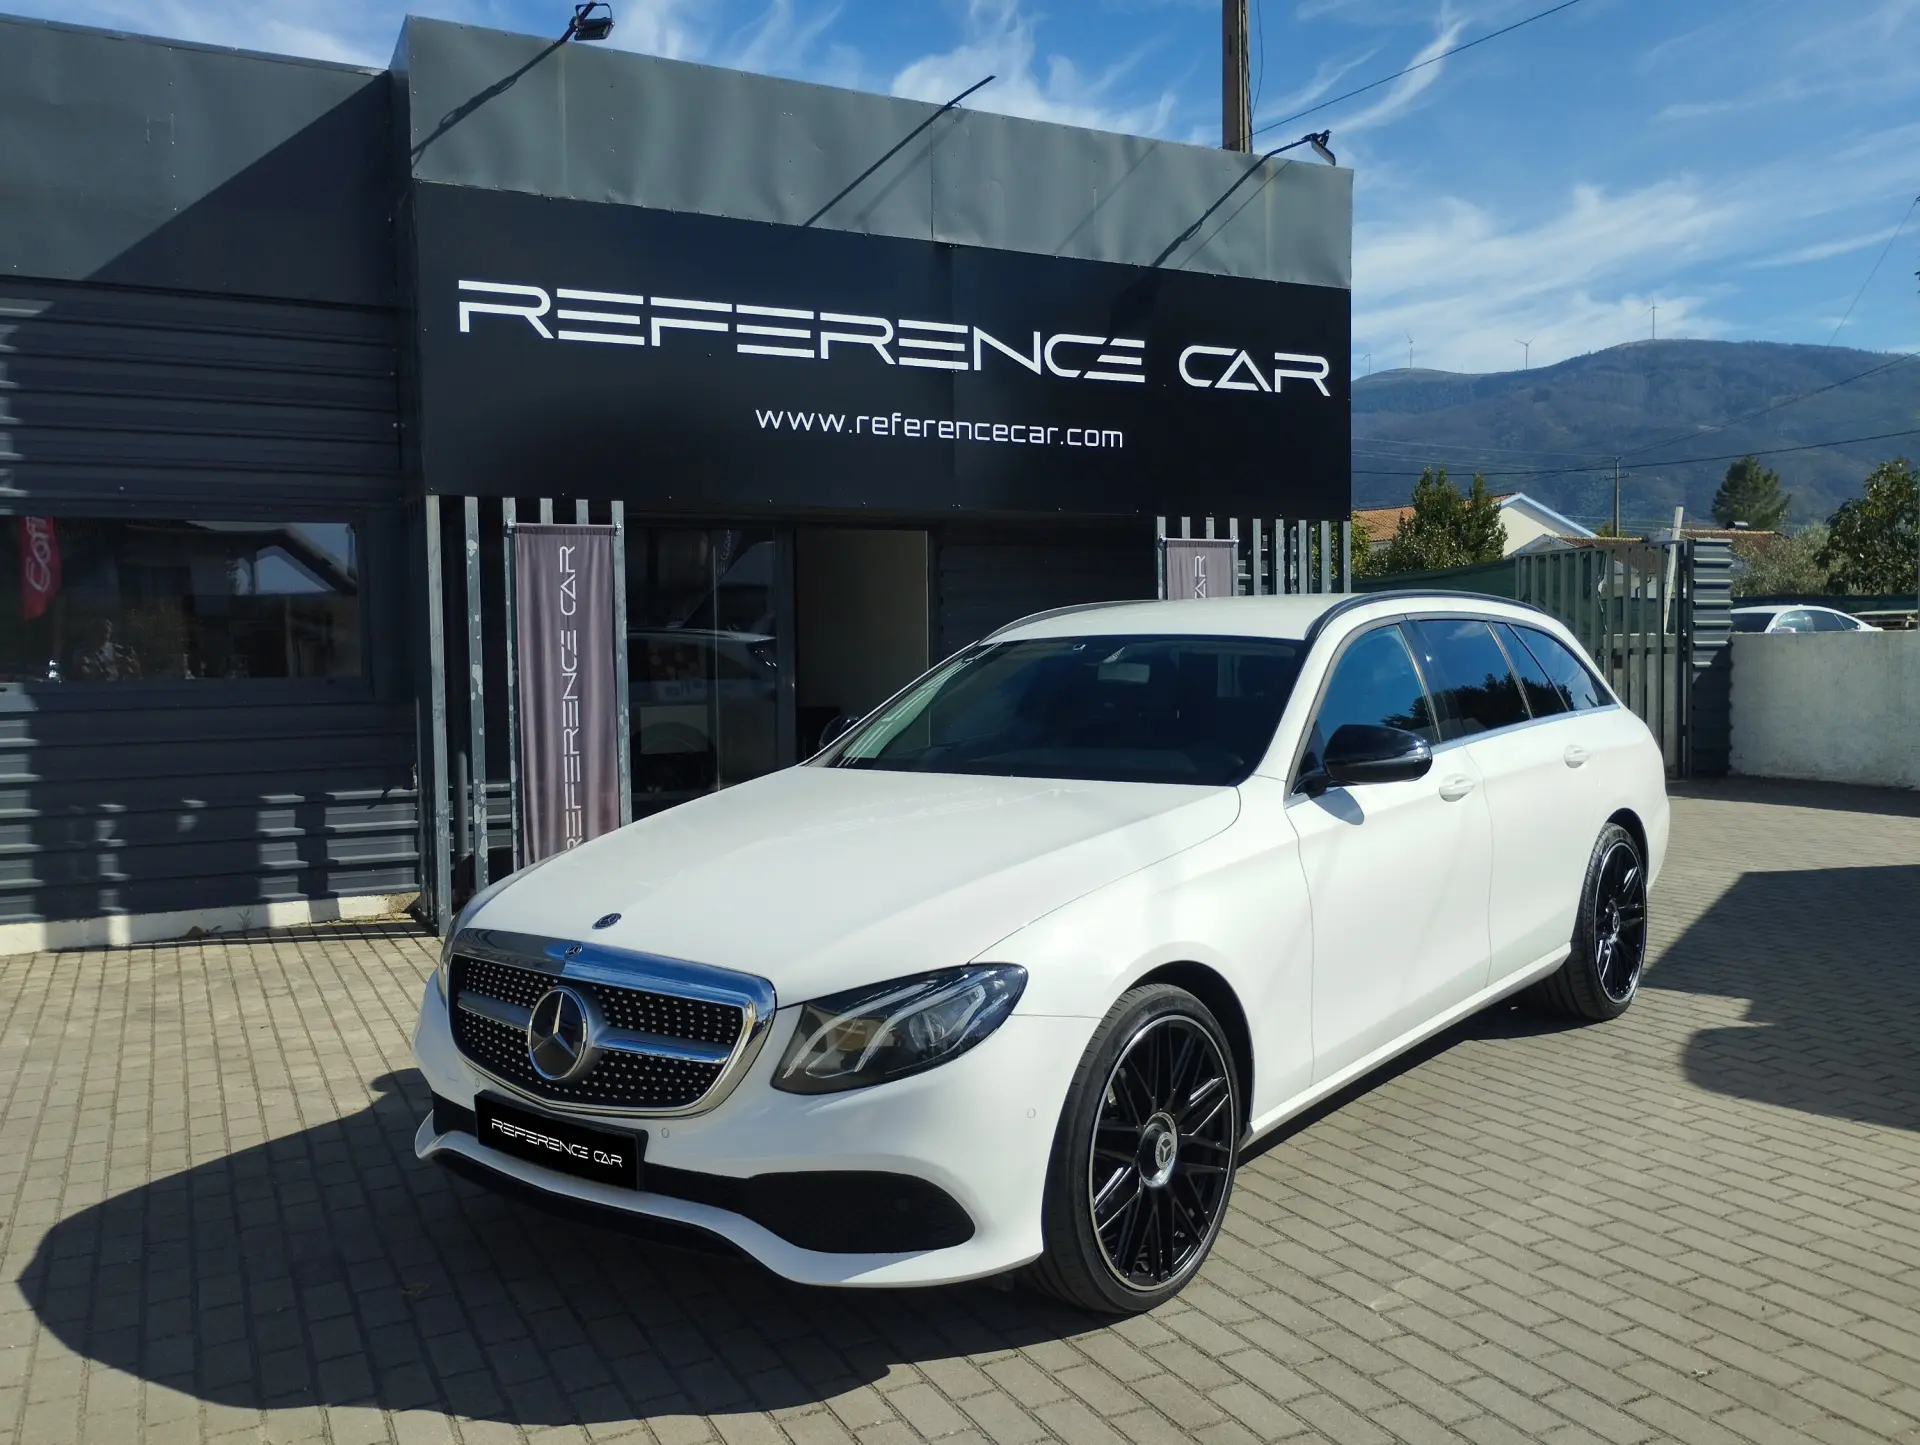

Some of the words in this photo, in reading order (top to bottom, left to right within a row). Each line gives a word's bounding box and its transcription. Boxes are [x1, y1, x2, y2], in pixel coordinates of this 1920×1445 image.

[459, 280, 1145, 382] REFERENCE
[1179, 346, 1330, 396] CAR
[756, 410, 1122, 447] www.referencecar.com
[559, 545, 576, 616] CAR
[1194, 555, 1206, 599] AR
[560, 629, 583, 850] REFERENCE
[491, 1118, 589, 1159] REFERENCE
[593, 1150, 623, 1168] CAR
